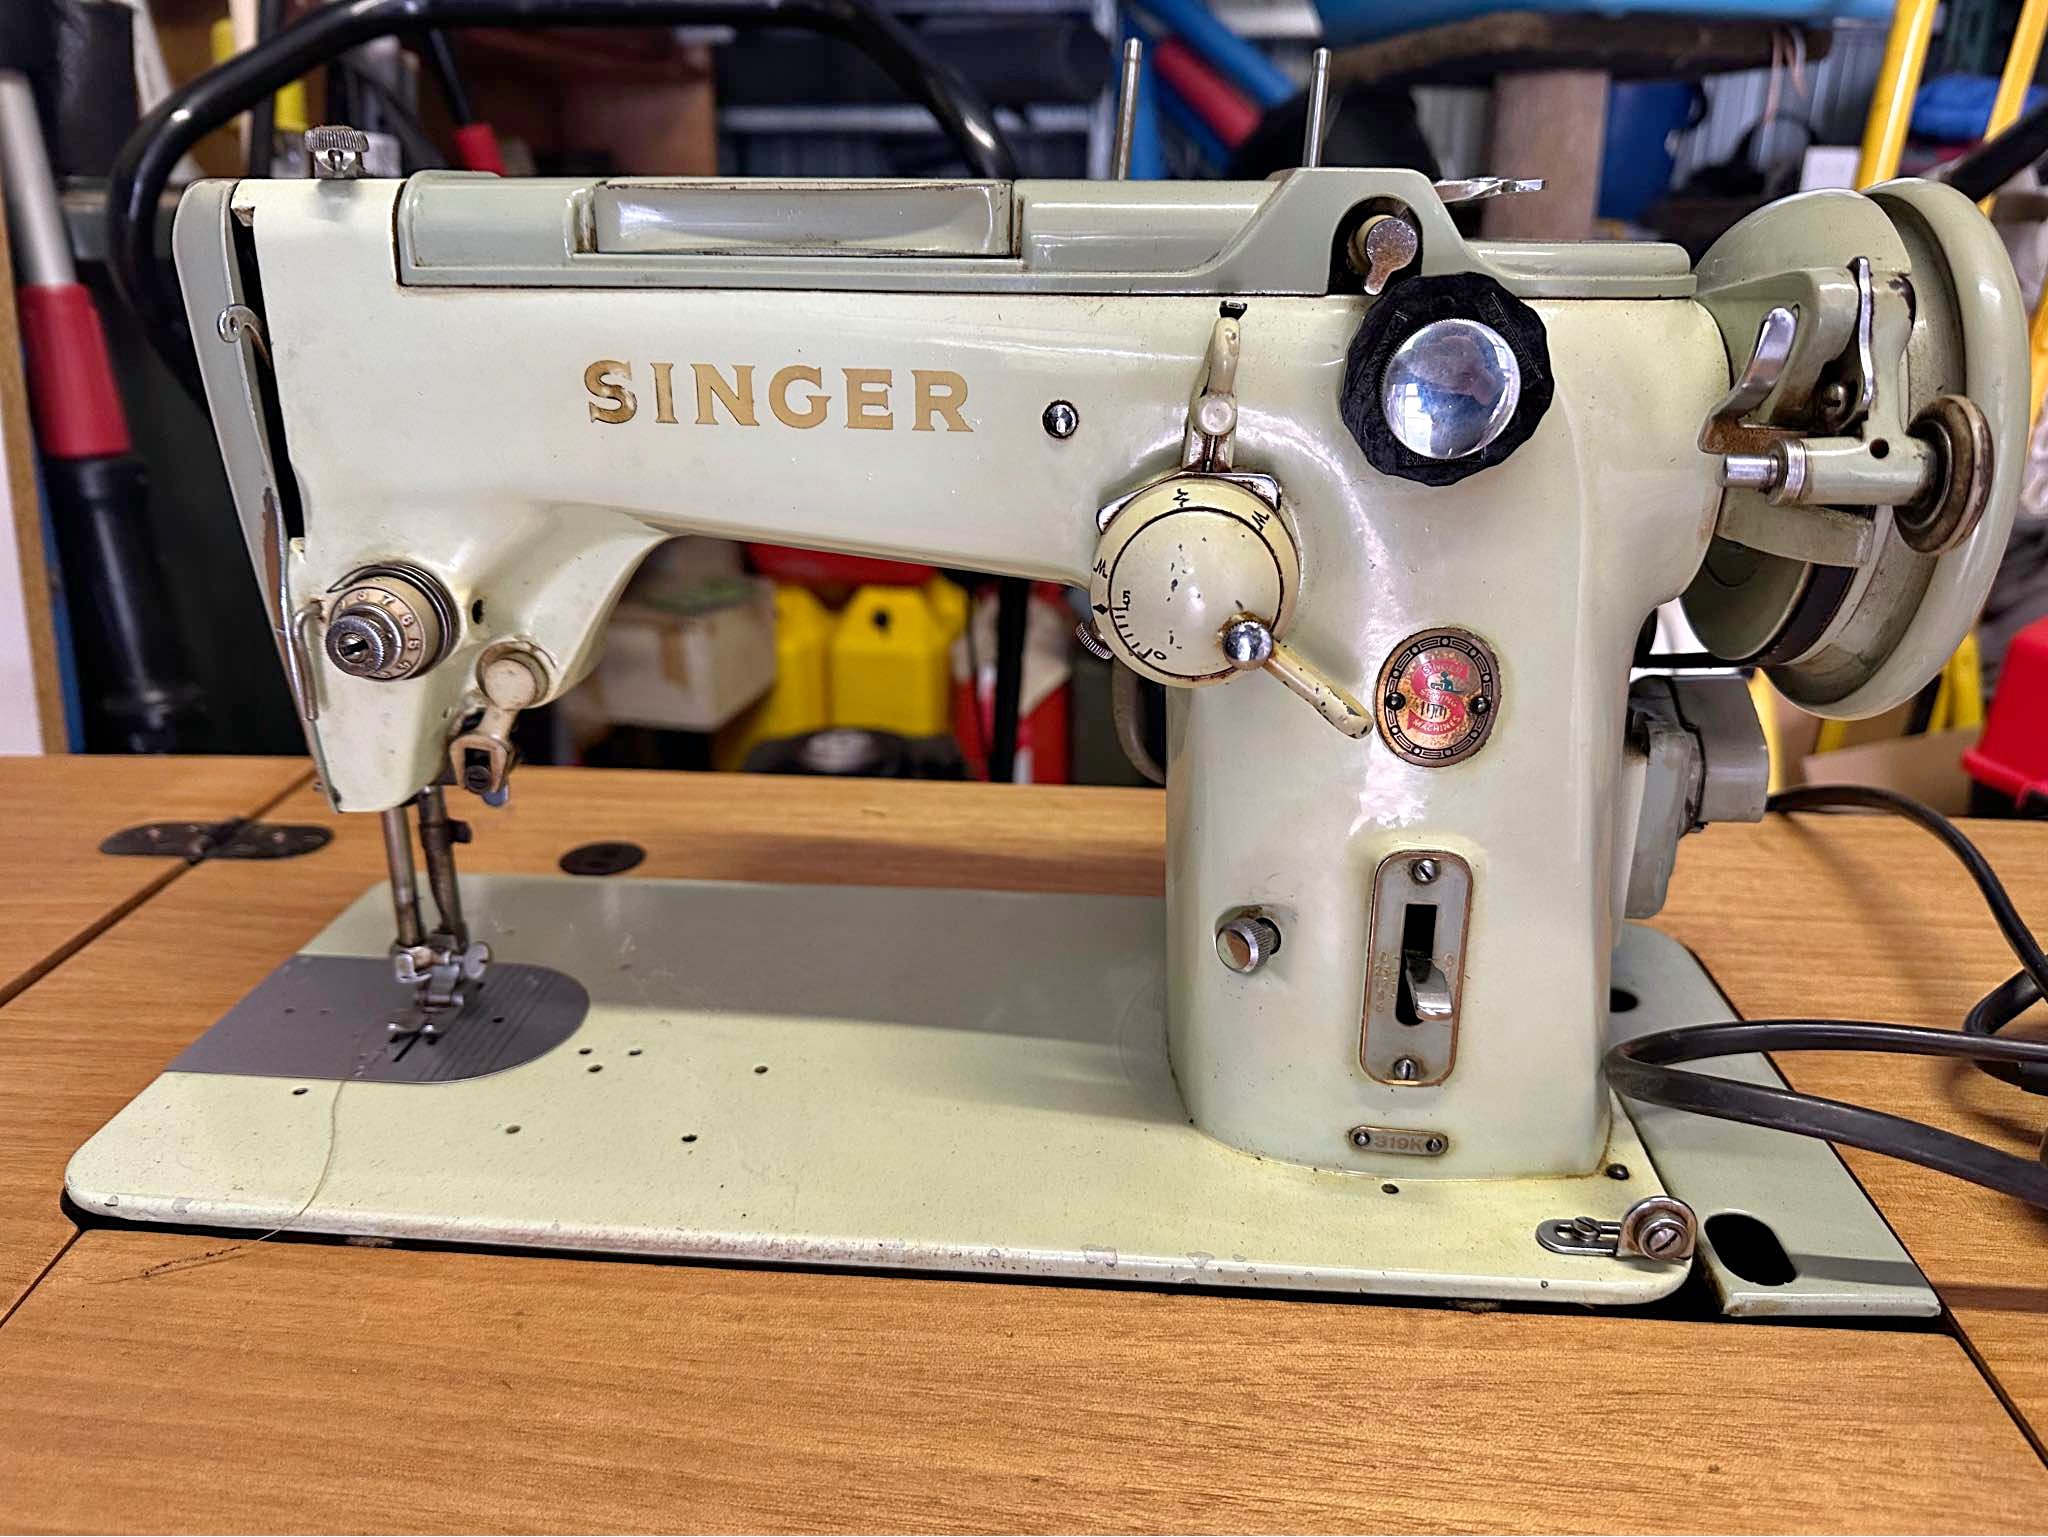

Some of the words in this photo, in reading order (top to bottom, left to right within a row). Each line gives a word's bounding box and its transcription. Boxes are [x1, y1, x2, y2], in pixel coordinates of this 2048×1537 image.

[583, 359, 974, 433] SINGER
[1122, 590, 1131, 606] 5
[1420, 688, 1457, 707] SEWING
[1412, 715, 1461, 732] MACHINES
